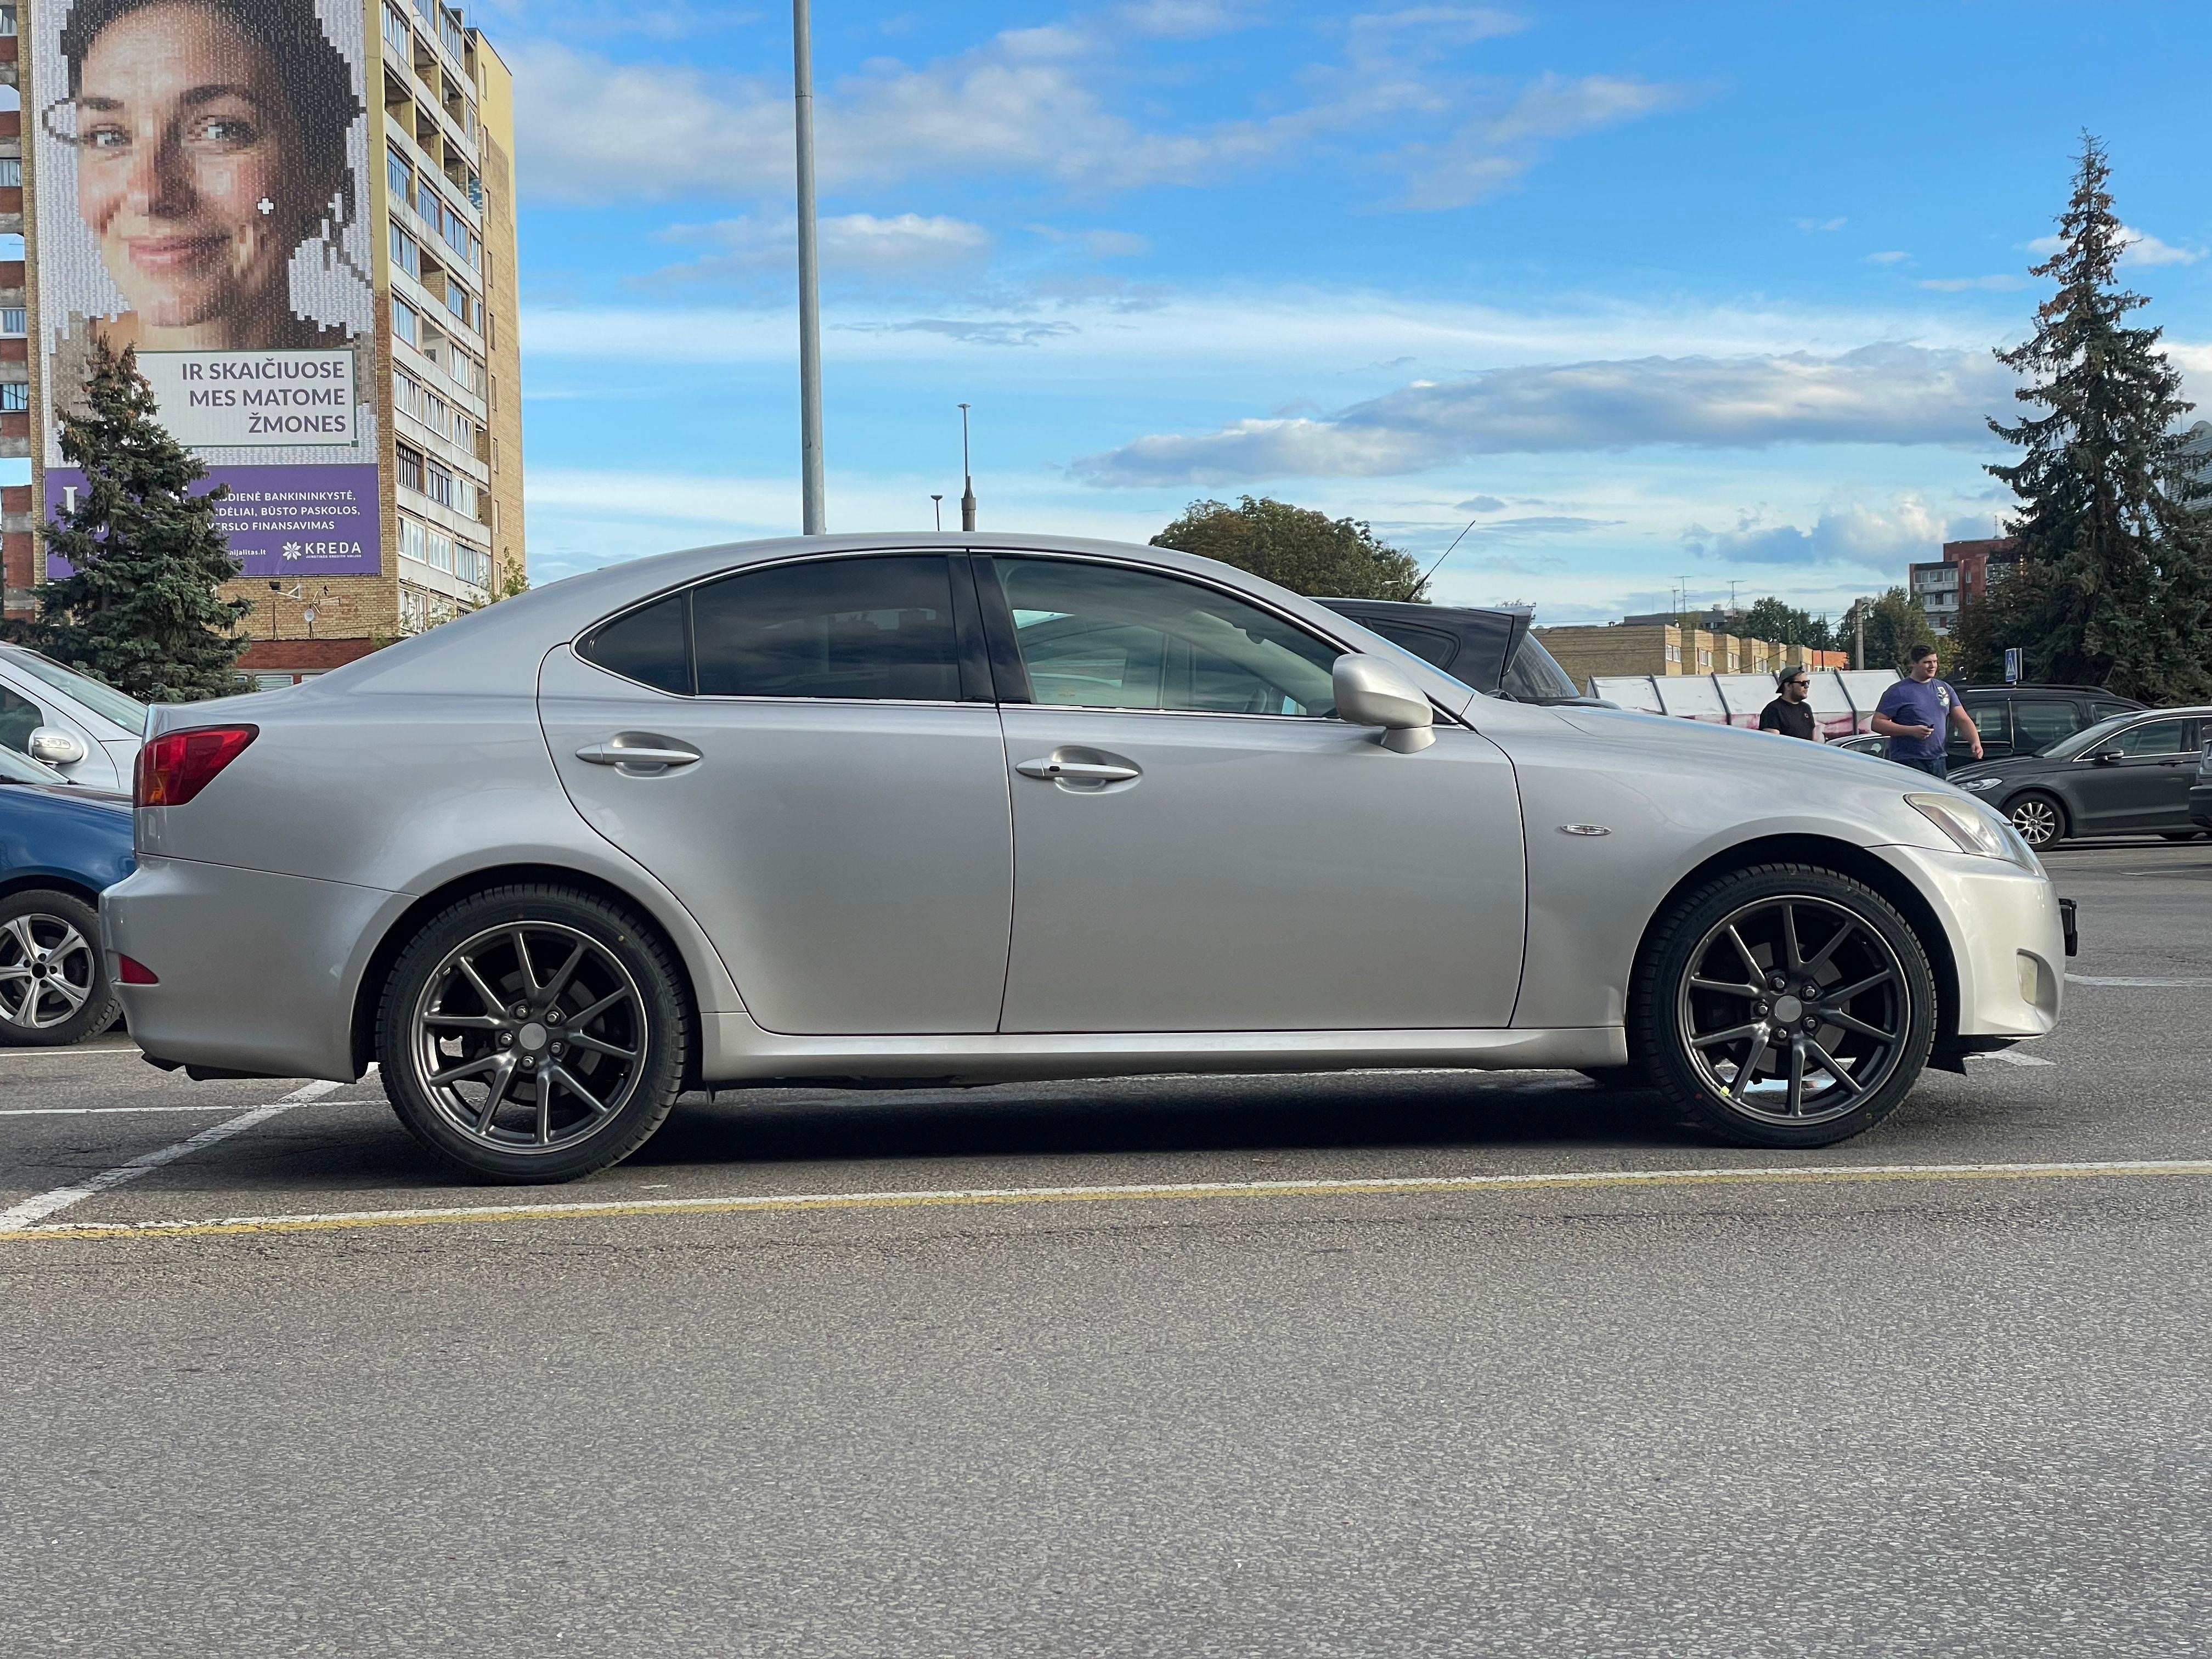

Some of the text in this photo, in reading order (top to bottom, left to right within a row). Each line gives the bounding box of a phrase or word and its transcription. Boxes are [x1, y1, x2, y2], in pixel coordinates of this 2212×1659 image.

[183, 358, 345, 380] IR SKAIČIUOSE
[190, 388, 345, 407] MES MATOME
[249, 412, 346, 433] ŽMONES
[207, 490, 356, 501] DIENĖ BANKININKYSTĖ,
[207, 506, 360, 517] DĖLIAI, BŪSTO PASKOLOS,
[252, 521, 335, 531] FINANSAVIMAS
[305, 541, 362, 554] KREDA
